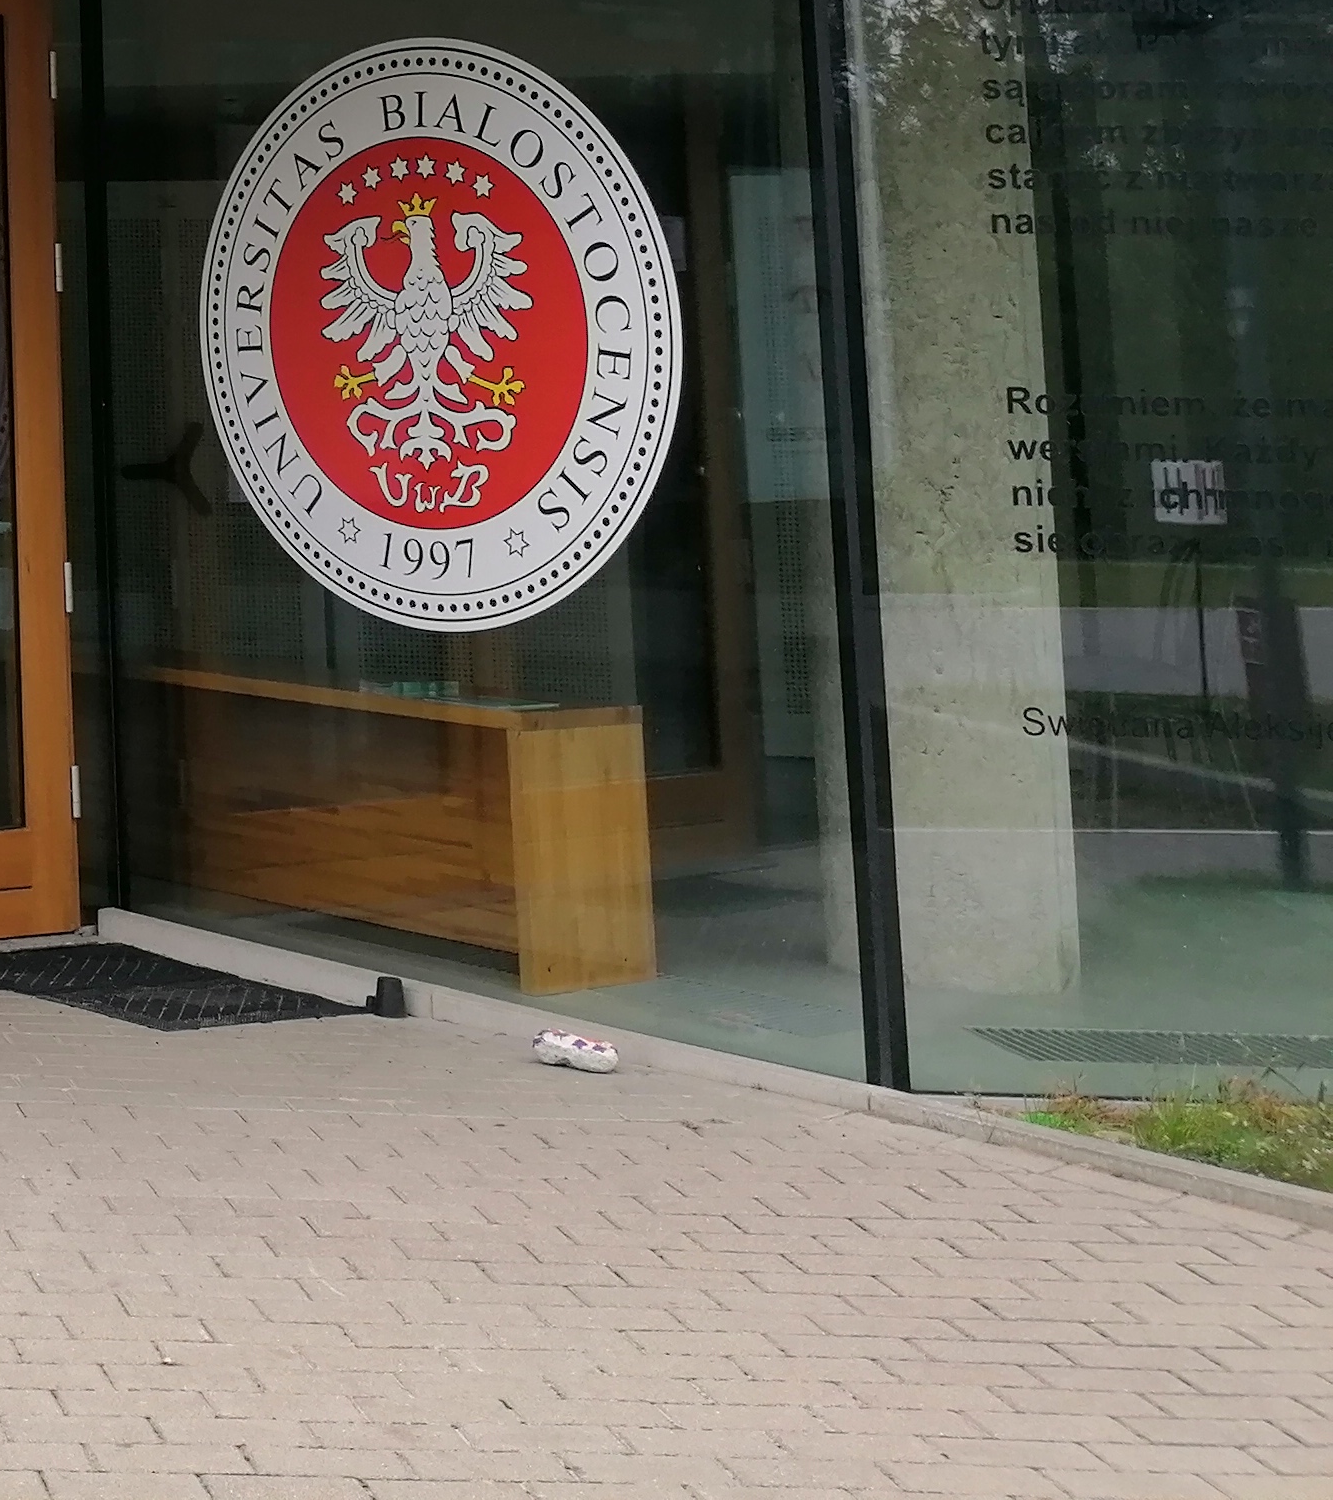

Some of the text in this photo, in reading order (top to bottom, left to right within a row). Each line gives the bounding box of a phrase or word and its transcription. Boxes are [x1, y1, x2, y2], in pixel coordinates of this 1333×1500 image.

[237, 118, 346, 519] UNIVERSITAS
[379, 90, 633, 533] BIALOSTOCENSIS
[369, 461, 491, 514] UwB
[379, 532, 476, 580] 1997
